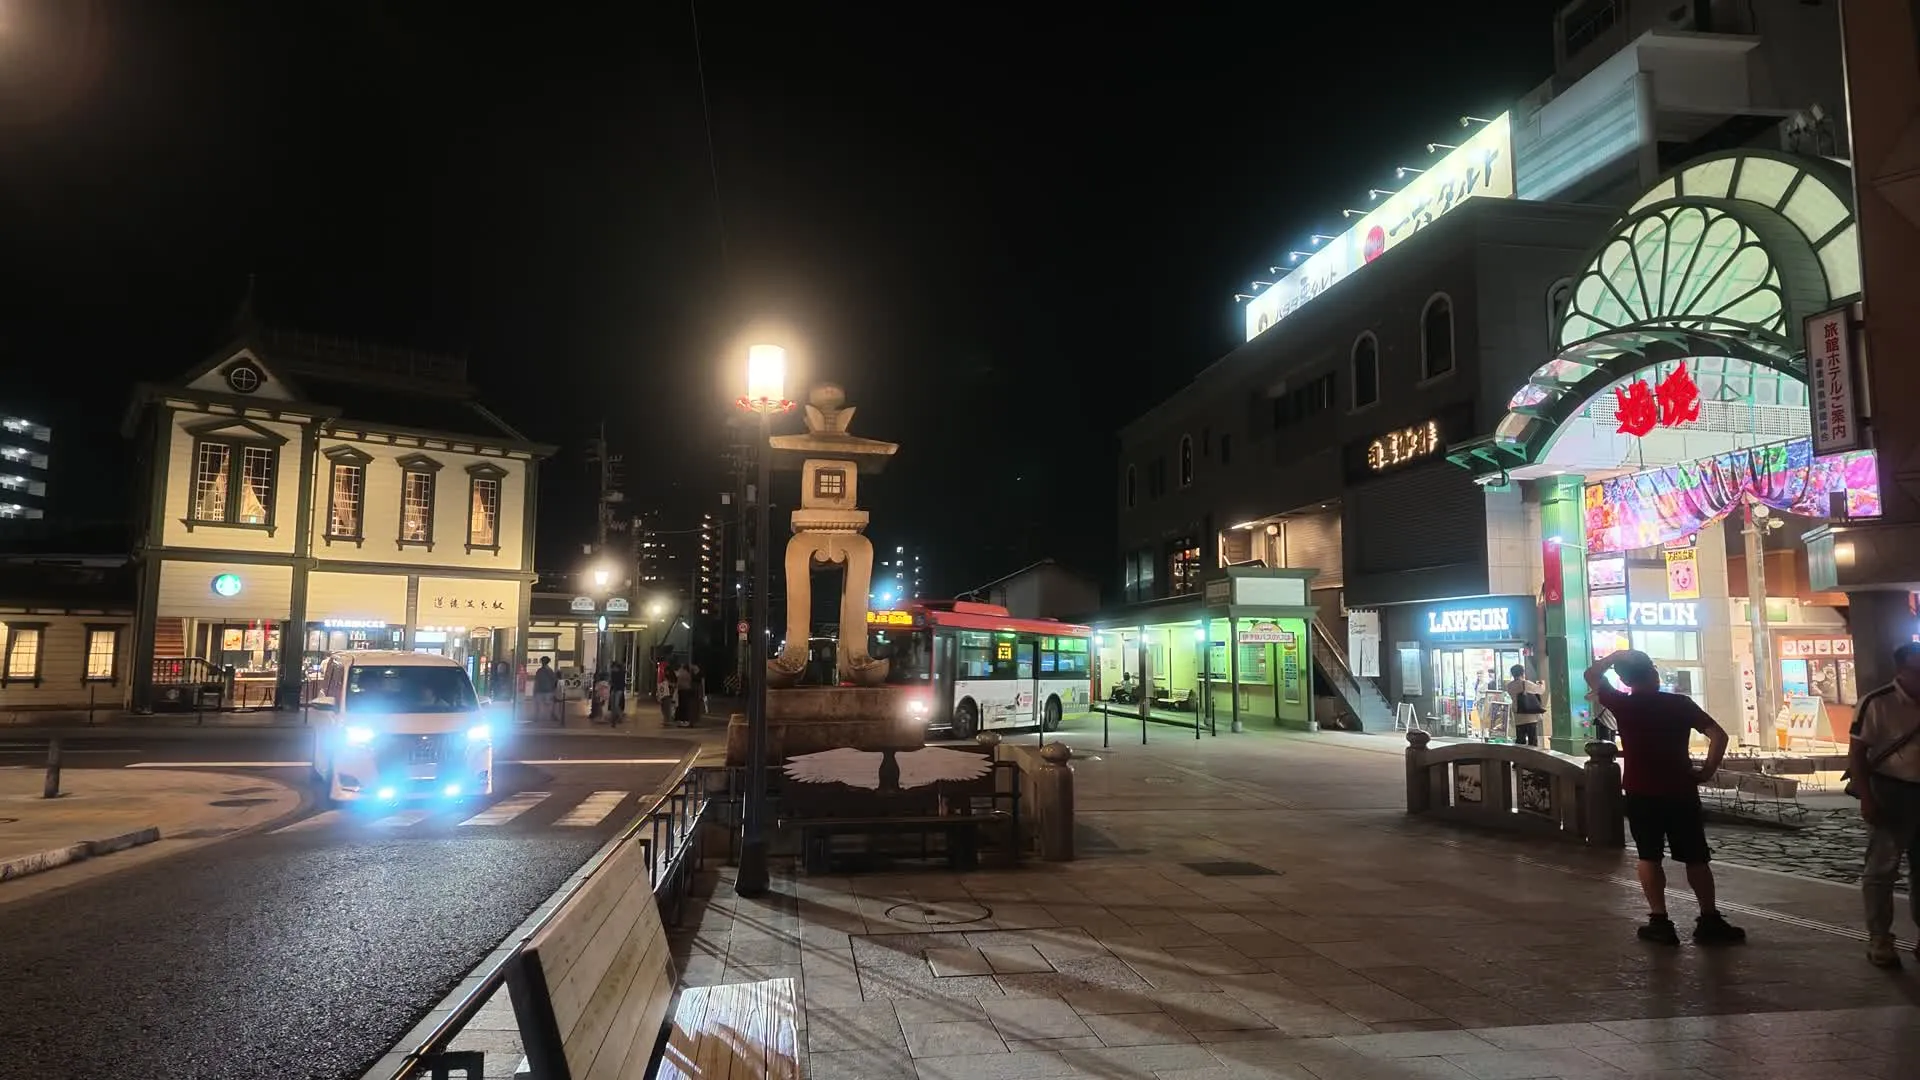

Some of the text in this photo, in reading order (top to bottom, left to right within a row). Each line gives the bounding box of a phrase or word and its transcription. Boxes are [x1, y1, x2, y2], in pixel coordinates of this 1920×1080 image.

[1824, 321, 1847, 441] 旅館ホテルご案内
[324, 618, 386, 629] STARBUCKS
[1428, 607, 1509, 632] LAWSON
